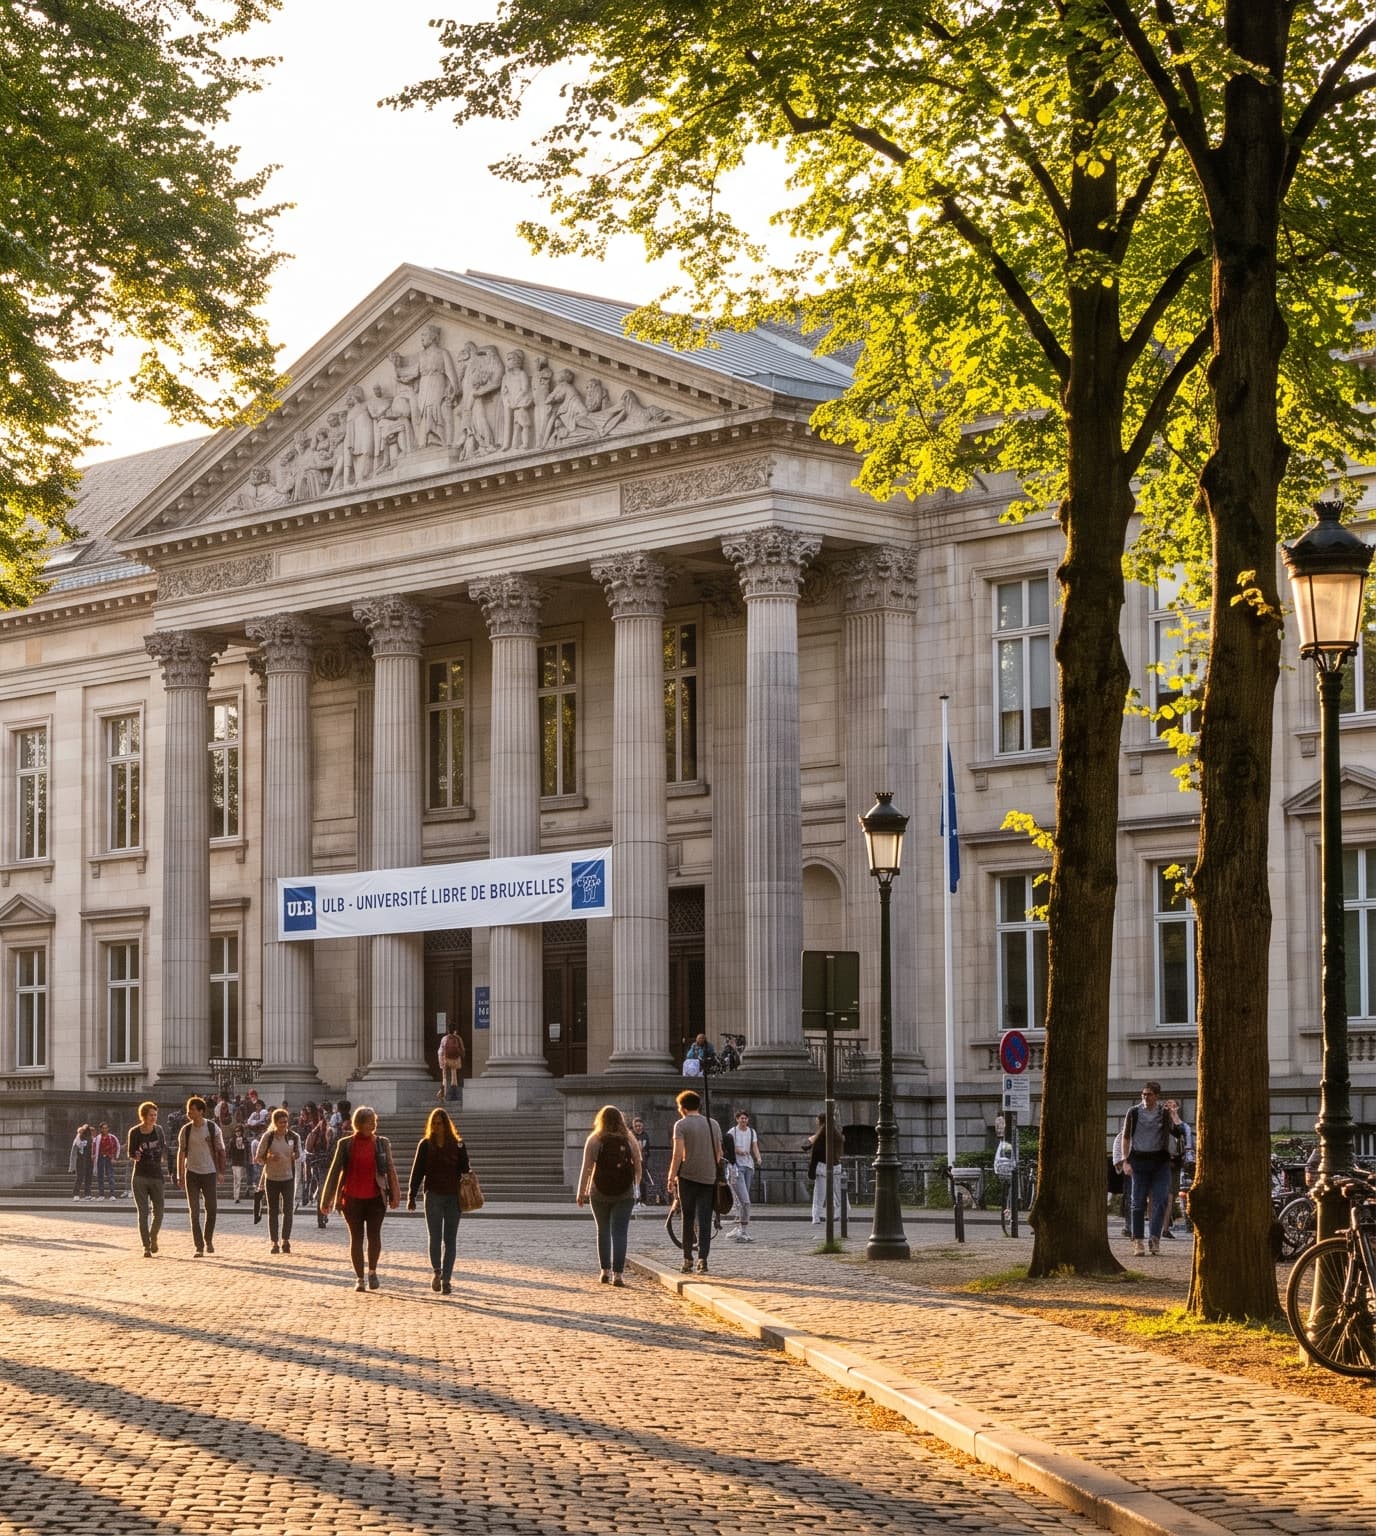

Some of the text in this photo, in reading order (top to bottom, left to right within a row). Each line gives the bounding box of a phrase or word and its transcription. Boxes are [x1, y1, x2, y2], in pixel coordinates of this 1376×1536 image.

[322, 897, 345, 913] ULB
[356, 886, 427, 911] UNIVERSITÉ
[431, 886, 467, 904] LIBRE
[471, 885, 486, 900] DE
[490, 877, 565, 899] BRUXELLES
[287, 901, 314, 917] ULB
